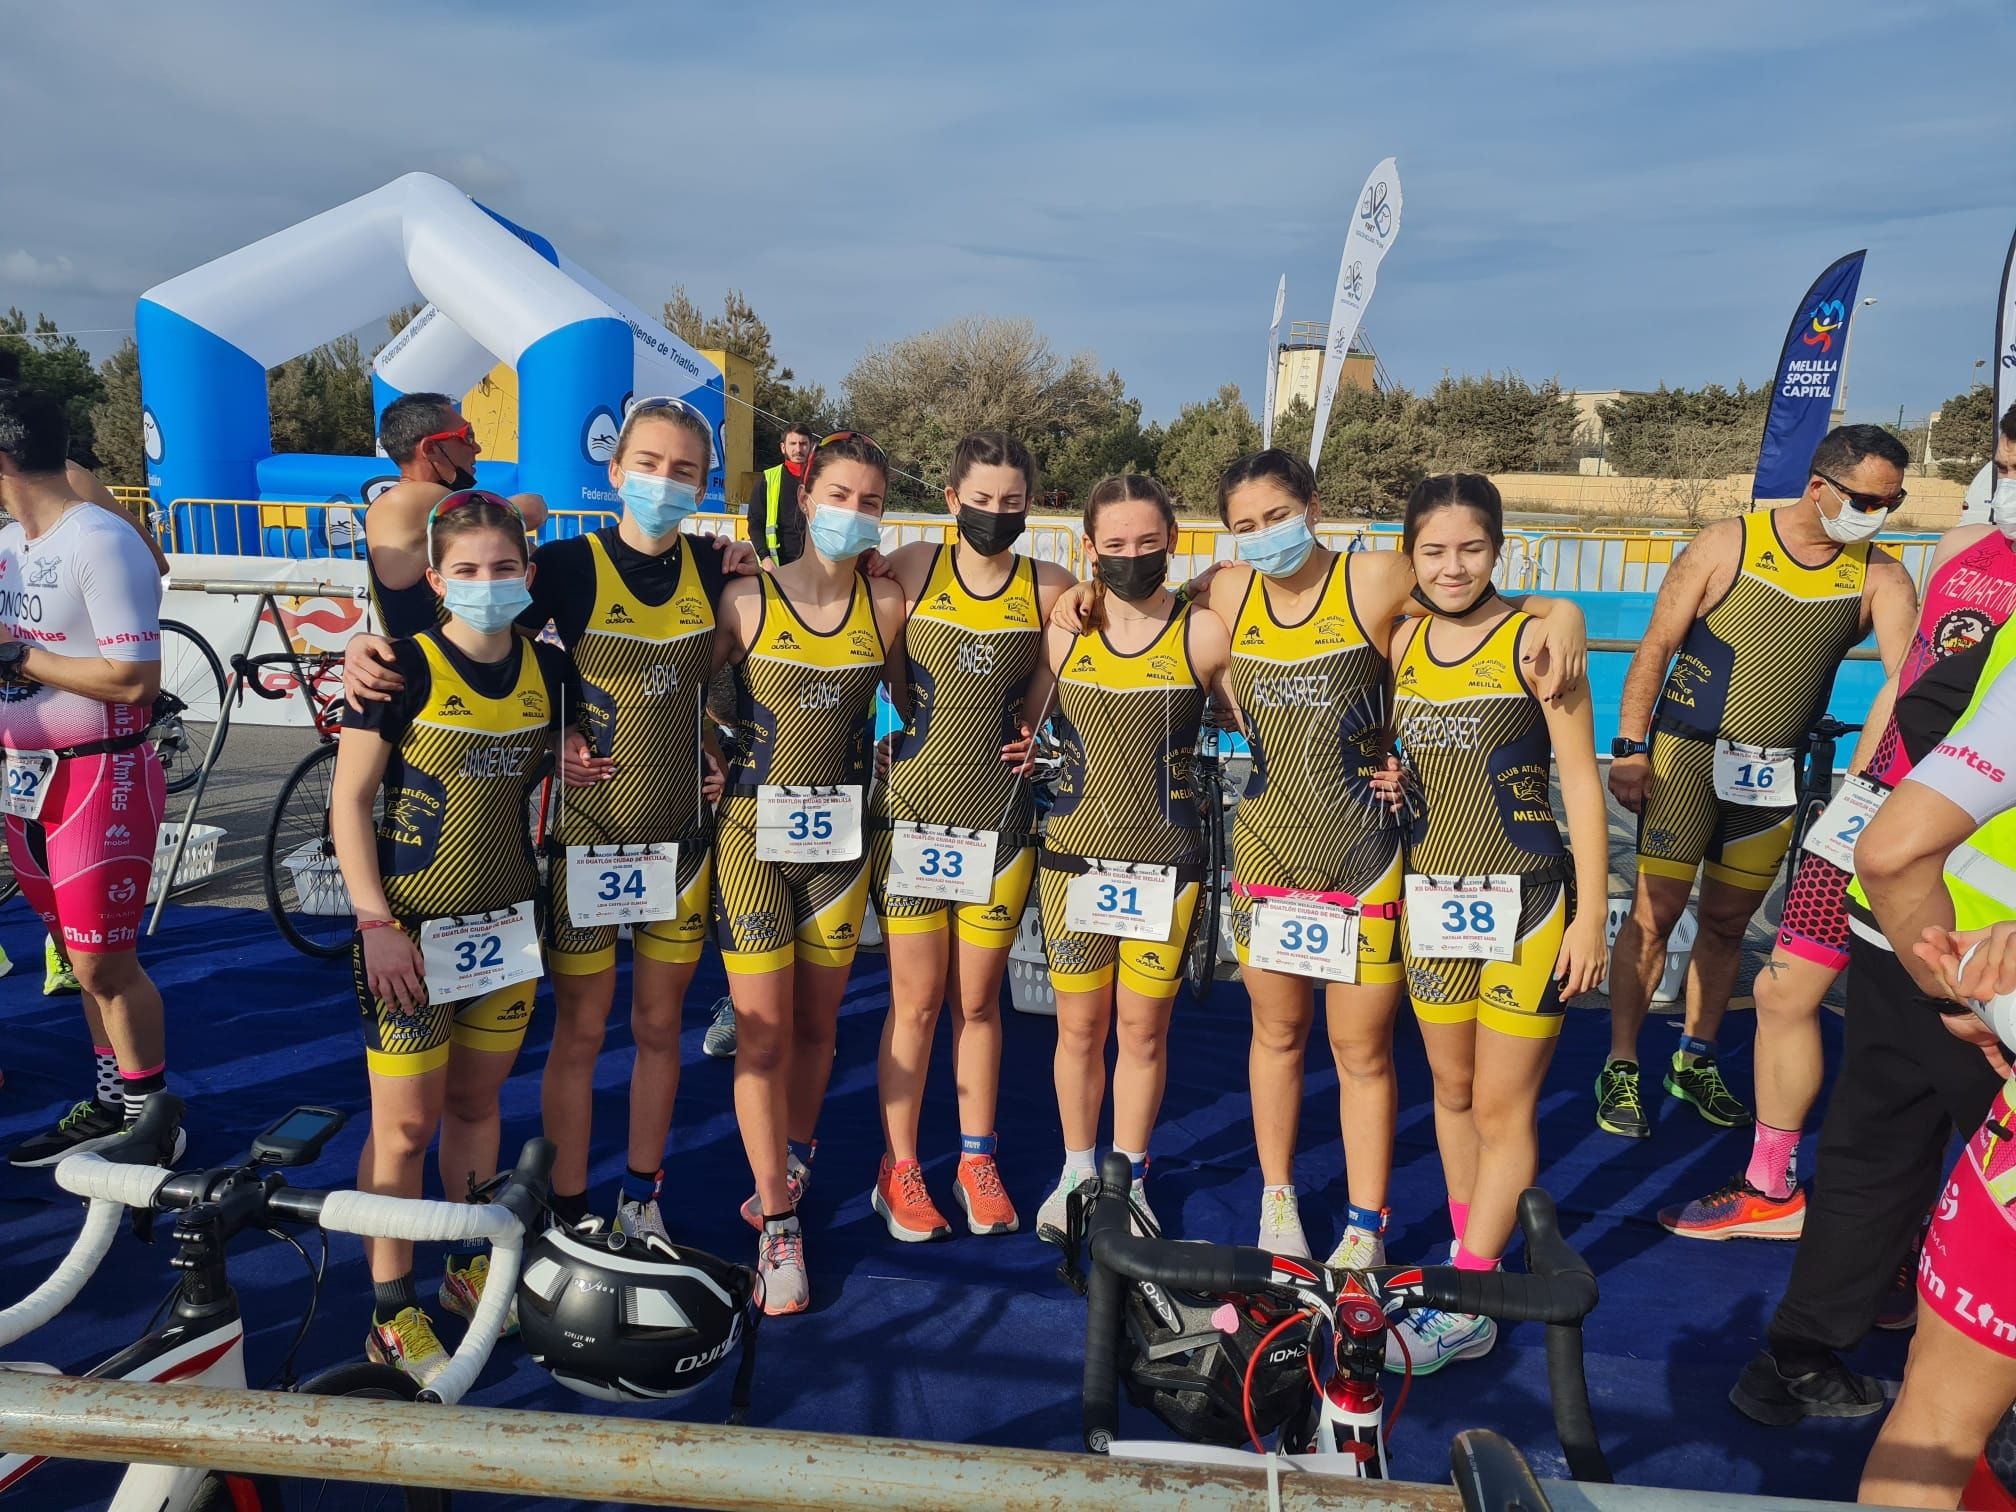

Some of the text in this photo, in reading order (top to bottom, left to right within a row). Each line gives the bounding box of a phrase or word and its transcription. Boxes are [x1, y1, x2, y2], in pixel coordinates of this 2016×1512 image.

[657, 341, 669, 356] de
[670, 348, 700, 377] Triatlón
[1788, 360, 1837, 372] MELILLA
[1782, 385, 1831, 398] CAPITAL
[1785, 373, 1830, 385] SPORT
[1314, 637, 1345, 645] MELILLA
[958, 637, 995, 675] INÉS
[643, 663, 678, 697] LIDIA
[1146, 672, 1175, 681] MELILLA
[1254, 670, 1332, 708] ÁLVAREZ
[1469, 681, 1502, 689] MELILLA
[800, 680, 841, 709] LUNA
[1402, 716, 1481, 750] BETORET
[458, 739, 533, 778] JIMÉNEZ
[9, 769, 38, 797] 22
[1497, 767, 1519, 782] CLUB
[1734, 764, 1775, 788] 16
[400, 786, 440, 809] ATLÉTICO
[378, 826, 423, 846] ELILLA
[787, 810, 833, 840] 35
[1836, 815, 1865, 844] 2
[919, 847, 964, 878] 33
[598, 869, 647, 901] 34
[1096, 884, 1142, 916] 31
[1441, 900, 1495, 933] 38
[63, 925, 103, 944] Club
[1280, 920, 1329, 954] 39
[454, 935, 504, 973] 32
[353, 943, 369, 1016] MELILLA
[392, 1029, 432, 1040] MELILLA
